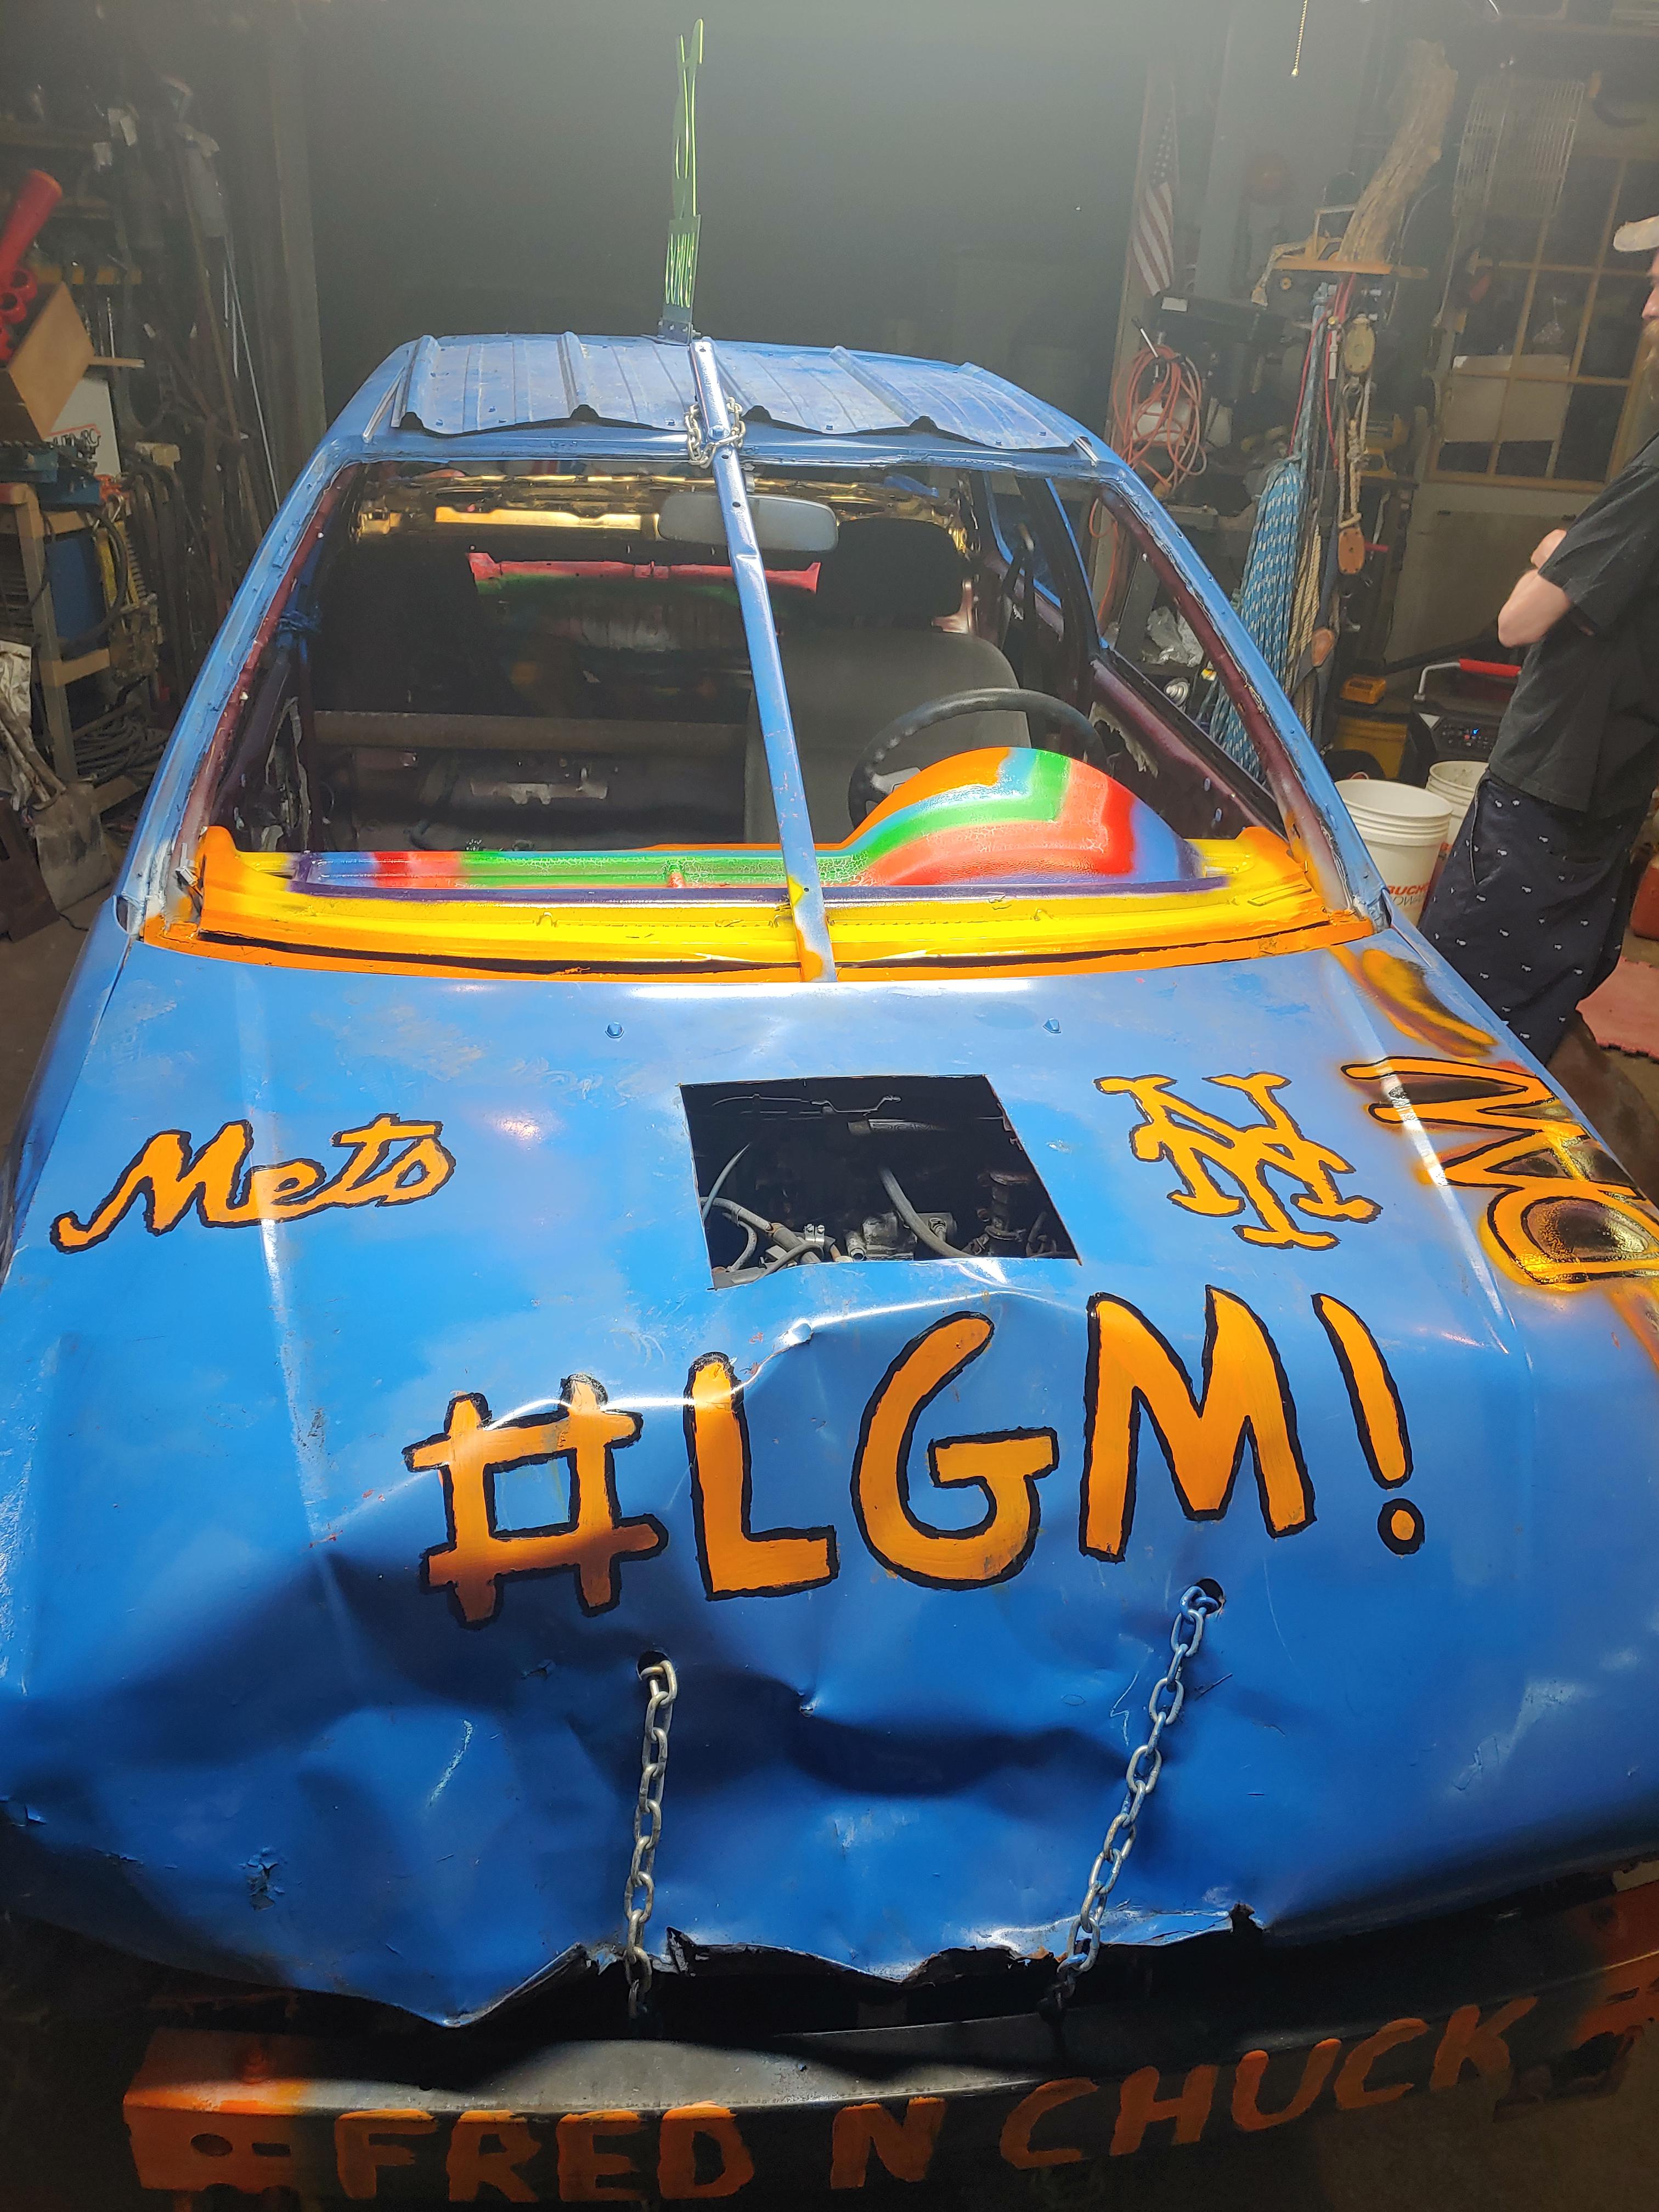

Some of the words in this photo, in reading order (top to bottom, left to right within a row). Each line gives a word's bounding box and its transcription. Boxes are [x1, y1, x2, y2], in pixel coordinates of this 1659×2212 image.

[50, 1113, 457, 1254] Mets
[402, 1284, 1426, 1629] #LGM!
[334, 2101, 755, 2203] FRED
[830, 2097, 947, 2190] N
[998, 1995, 1539, 2171] CHUCK
